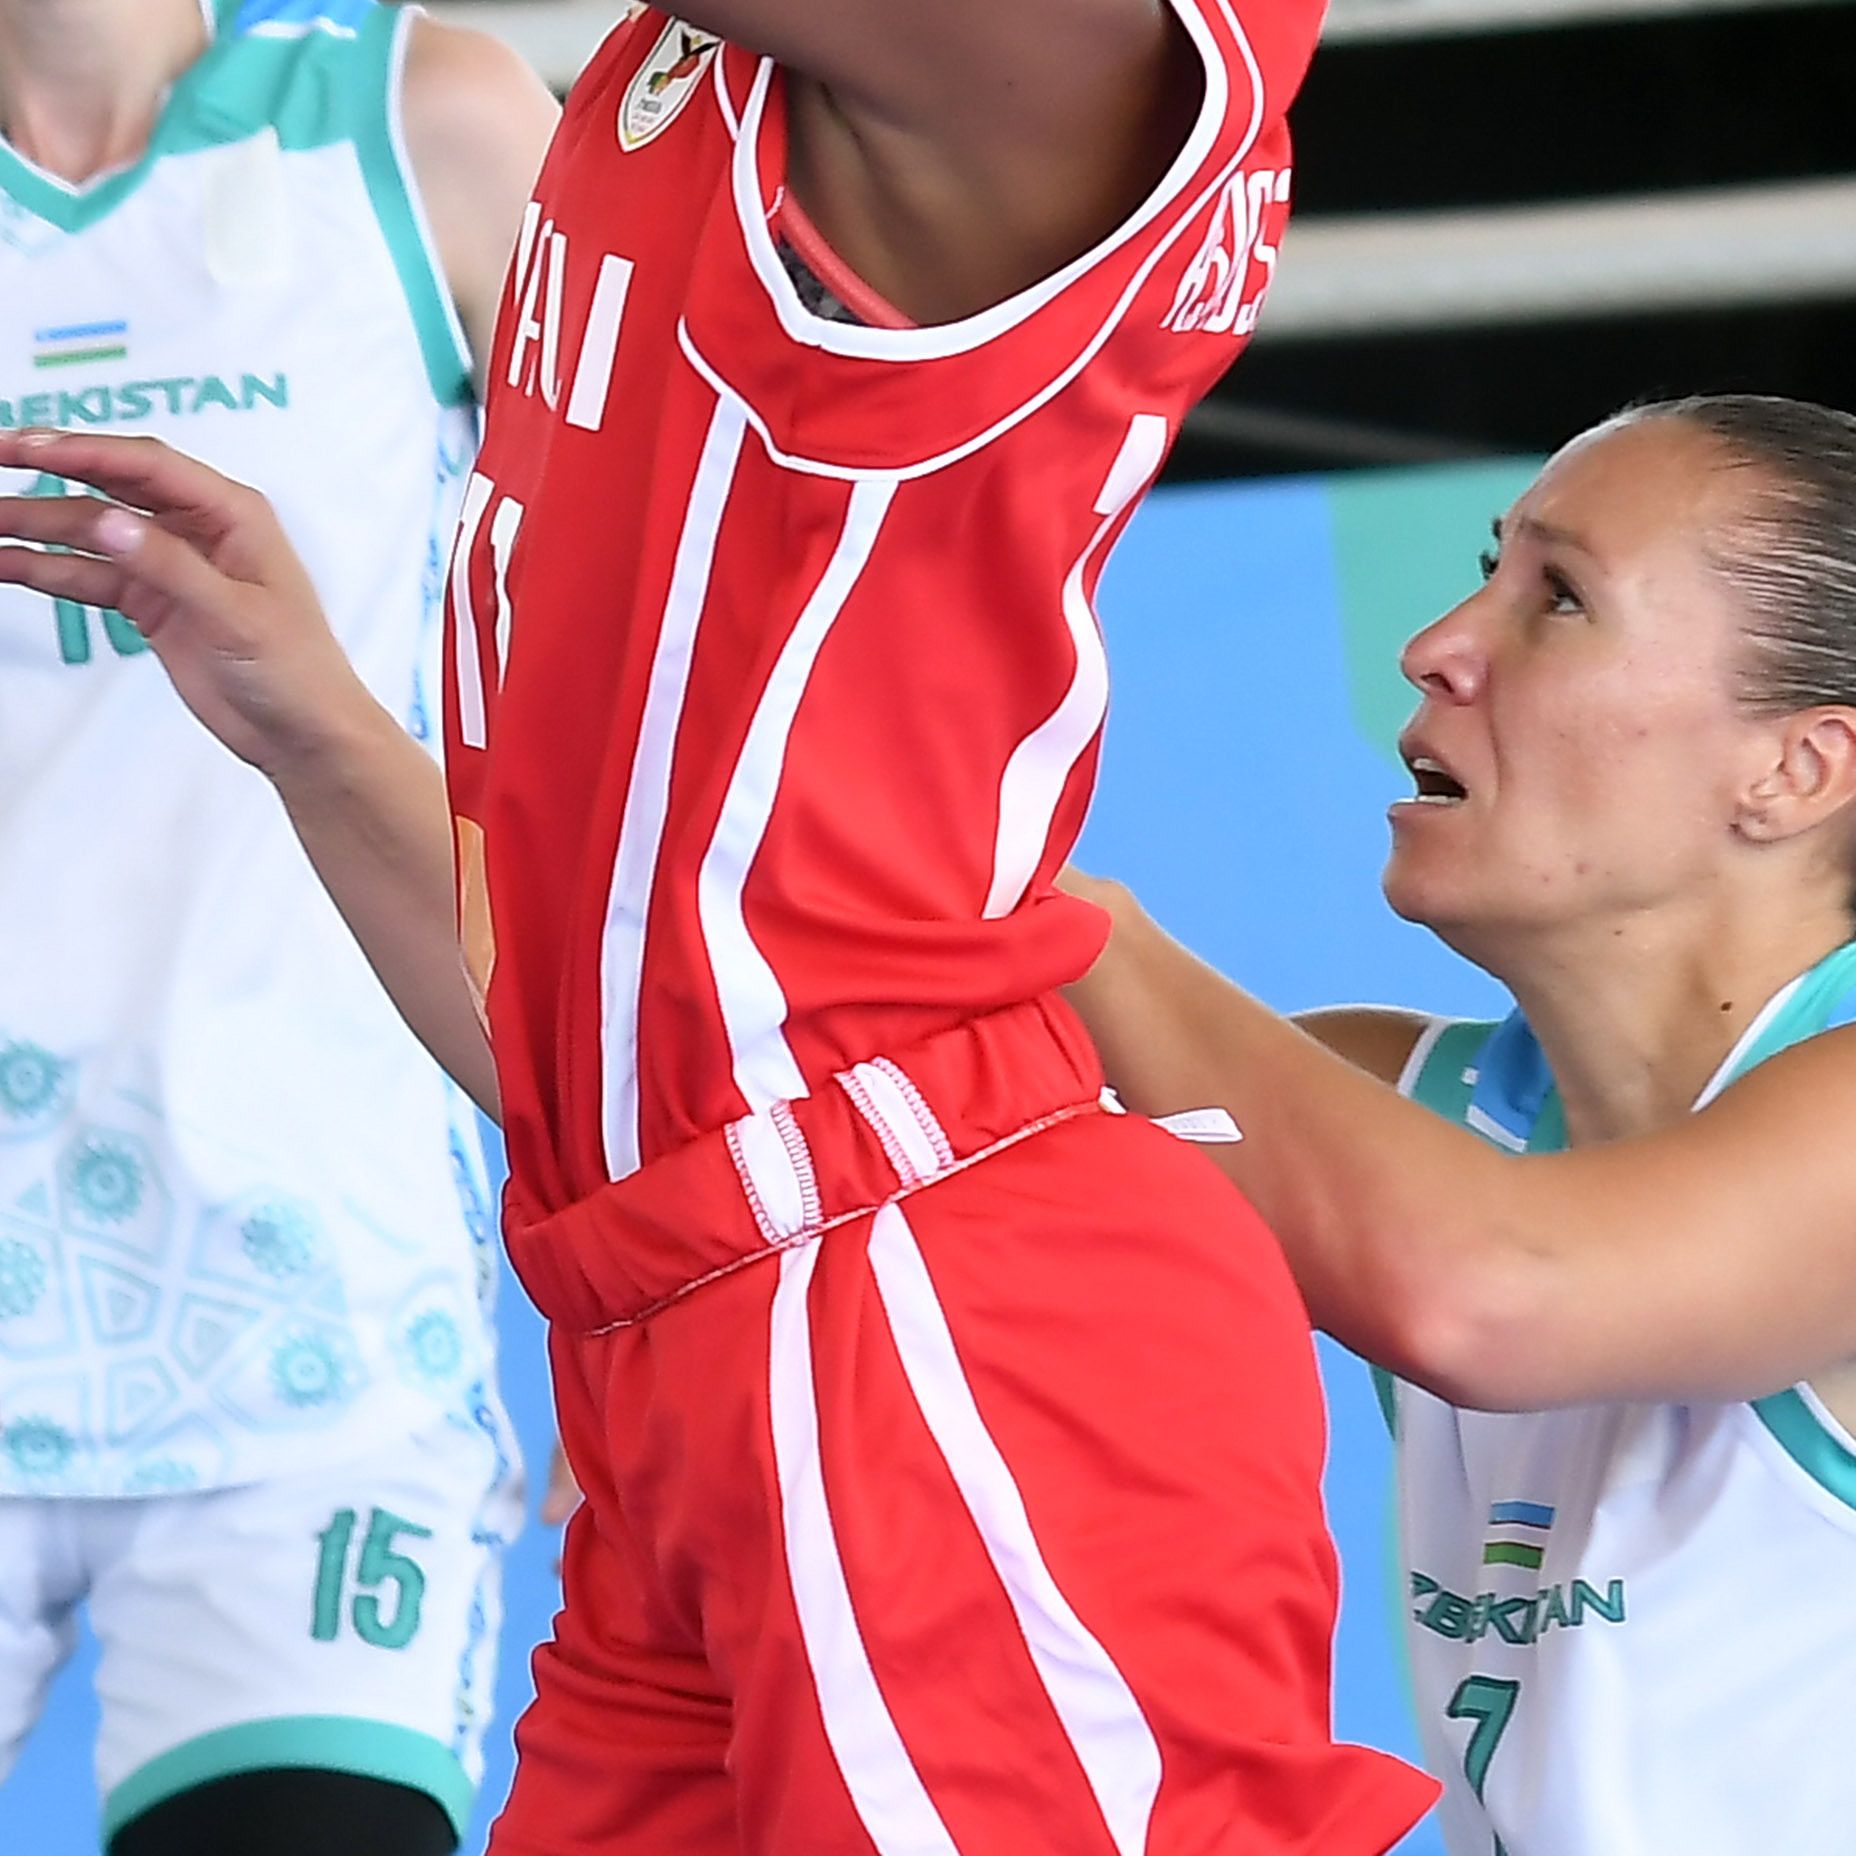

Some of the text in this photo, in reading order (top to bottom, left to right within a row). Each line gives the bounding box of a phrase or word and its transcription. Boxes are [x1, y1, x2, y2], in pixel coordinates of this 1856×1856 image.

[512, 199, 636, 432] ALI
[309, 1505, 434, 1650] 15
[1445, 1674, 1521, 1856] 7
